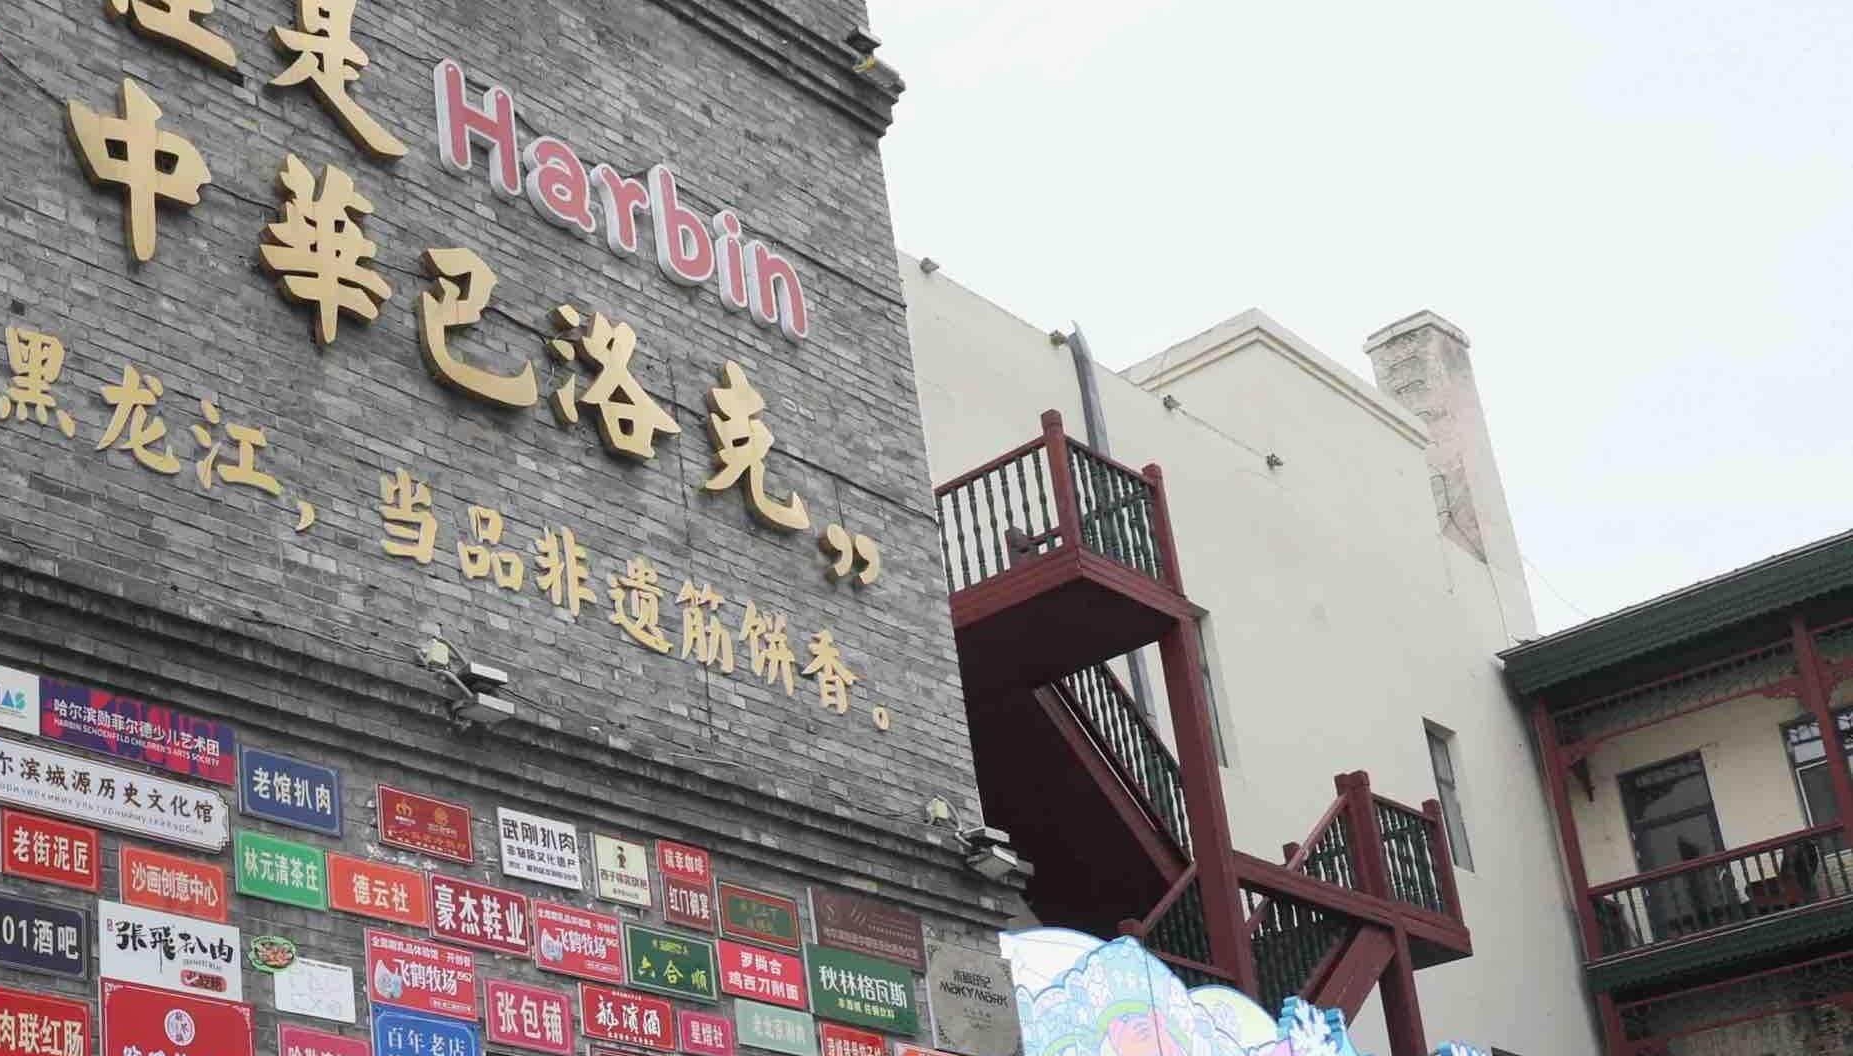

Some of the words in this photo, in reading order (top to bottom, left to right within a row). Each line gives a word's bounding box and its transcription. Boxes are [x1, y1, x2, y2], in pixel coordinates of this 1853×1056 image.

[433, 58, 810, 342] Harbin
[253, 768, 331, 815] 老馆扒肉
[12, 827, 89, 874] 老街泥匠
[503, 818, 575, 854] 武刚扒肉
[132, 862, 219, 907] 沙画创意中心
[352, 872, 409, 912] 德云社
[436, 884, 525, 945] 豪杰鞋业
[557, 928, 606, 958] 飞鹤牧场
[394, 959, 458, 995] 飞鹤牧场
[819, 966, 907, 1008] 秋林格瓦斯
[496, 991, 563, 1044] 张包铺
